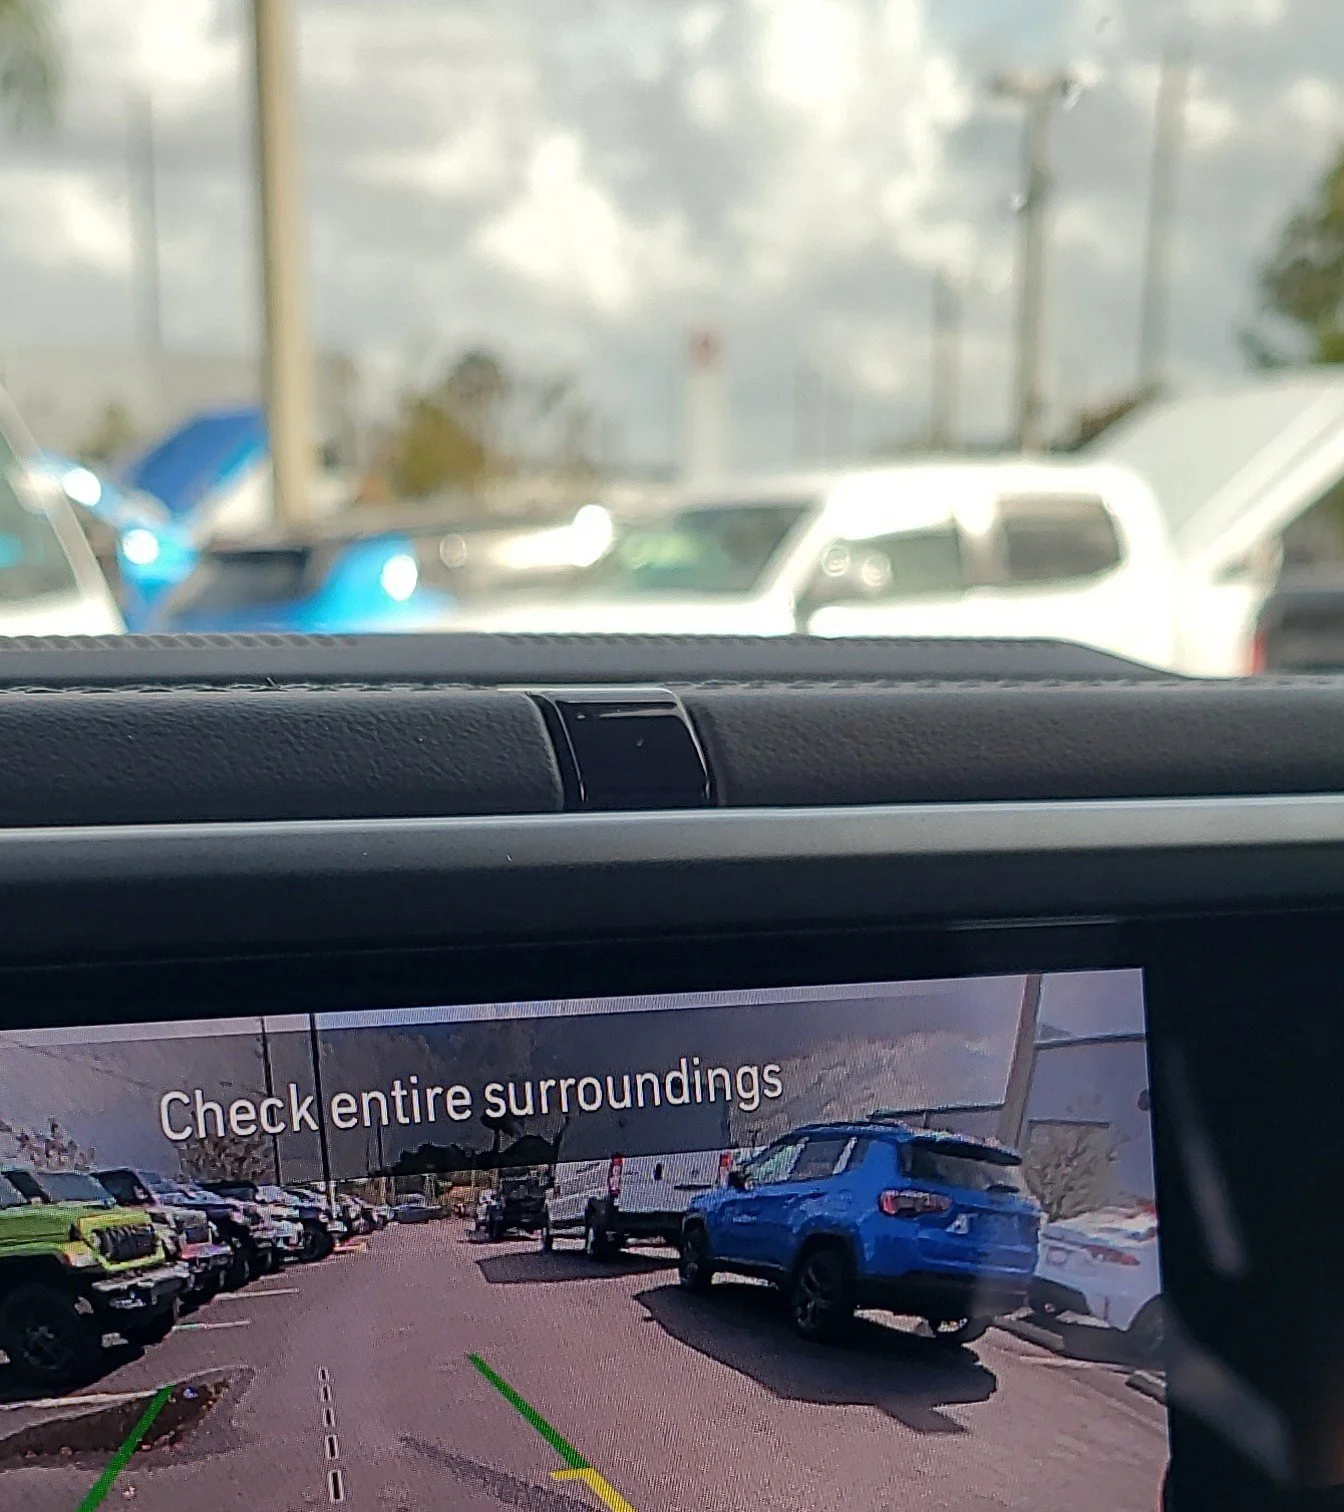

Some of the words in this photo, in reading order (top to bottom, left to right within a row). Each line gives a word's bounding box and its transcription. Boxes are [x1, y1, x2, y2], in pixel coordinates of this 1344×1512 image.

[158, 1082, 320, 1142] Check
[329, 1075, 472, 1131] entire
[483, 1056, 784, 1119] surroundings
